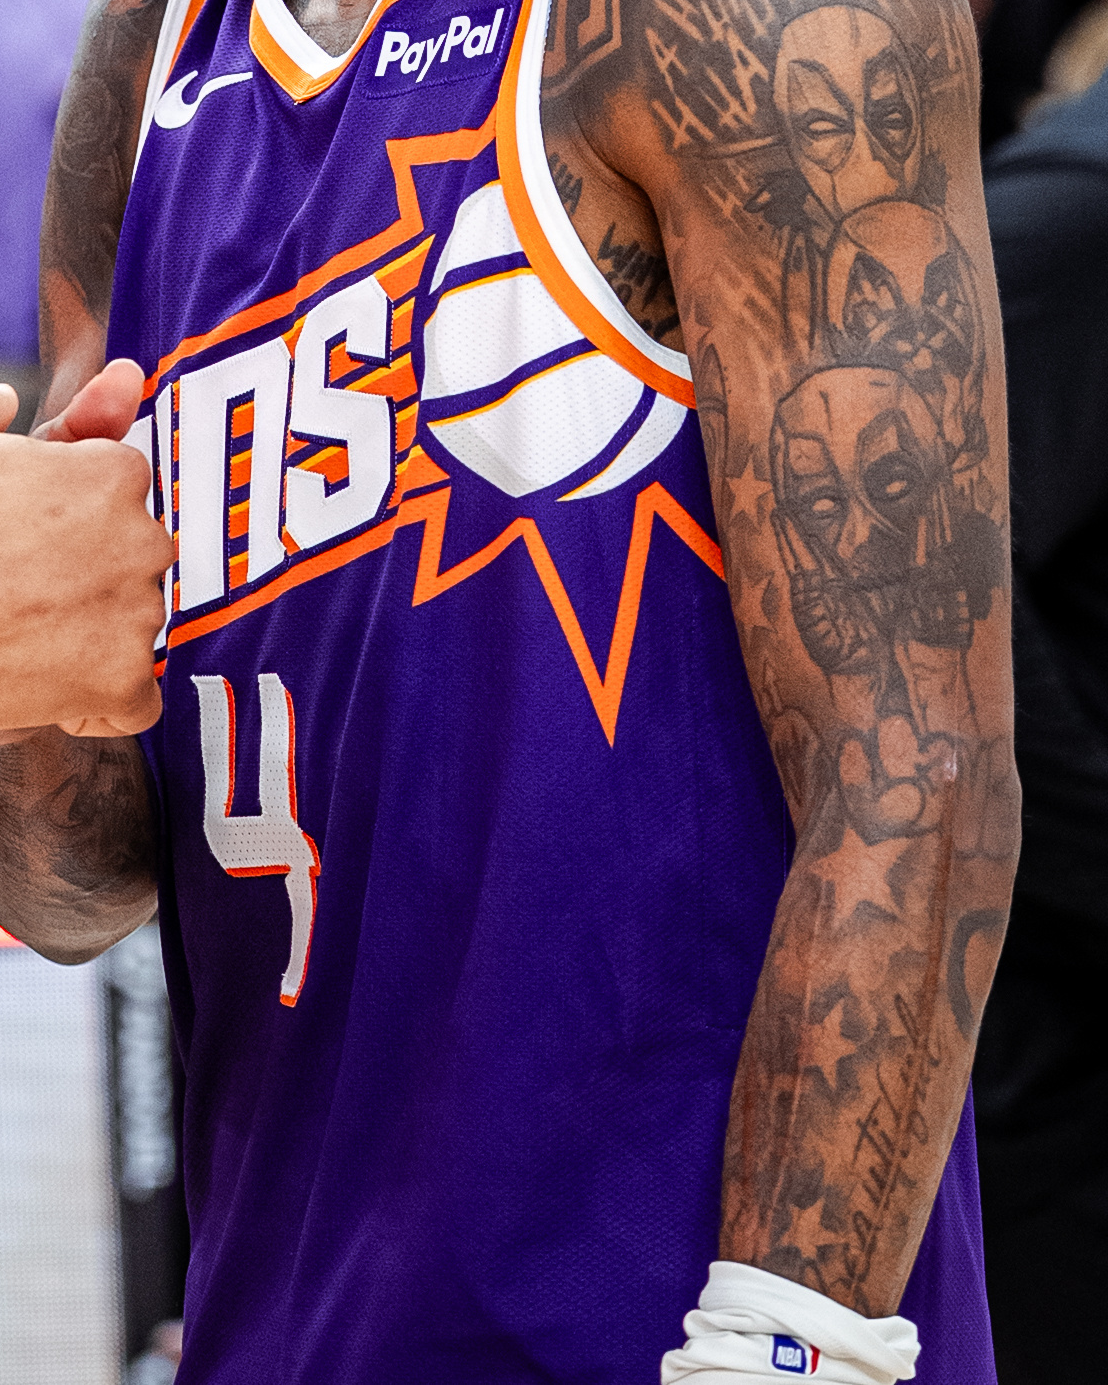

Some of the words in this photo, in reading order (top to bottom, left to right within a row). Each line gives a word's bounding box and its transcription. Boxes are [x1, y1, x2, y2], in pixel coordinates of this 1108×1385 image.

[375, 8, 504, 83] PayPal
[114, 275, 395, 649] NS
[191, 673, 320, 1007] 4
[775, 1345, 803, 1369] NBA
